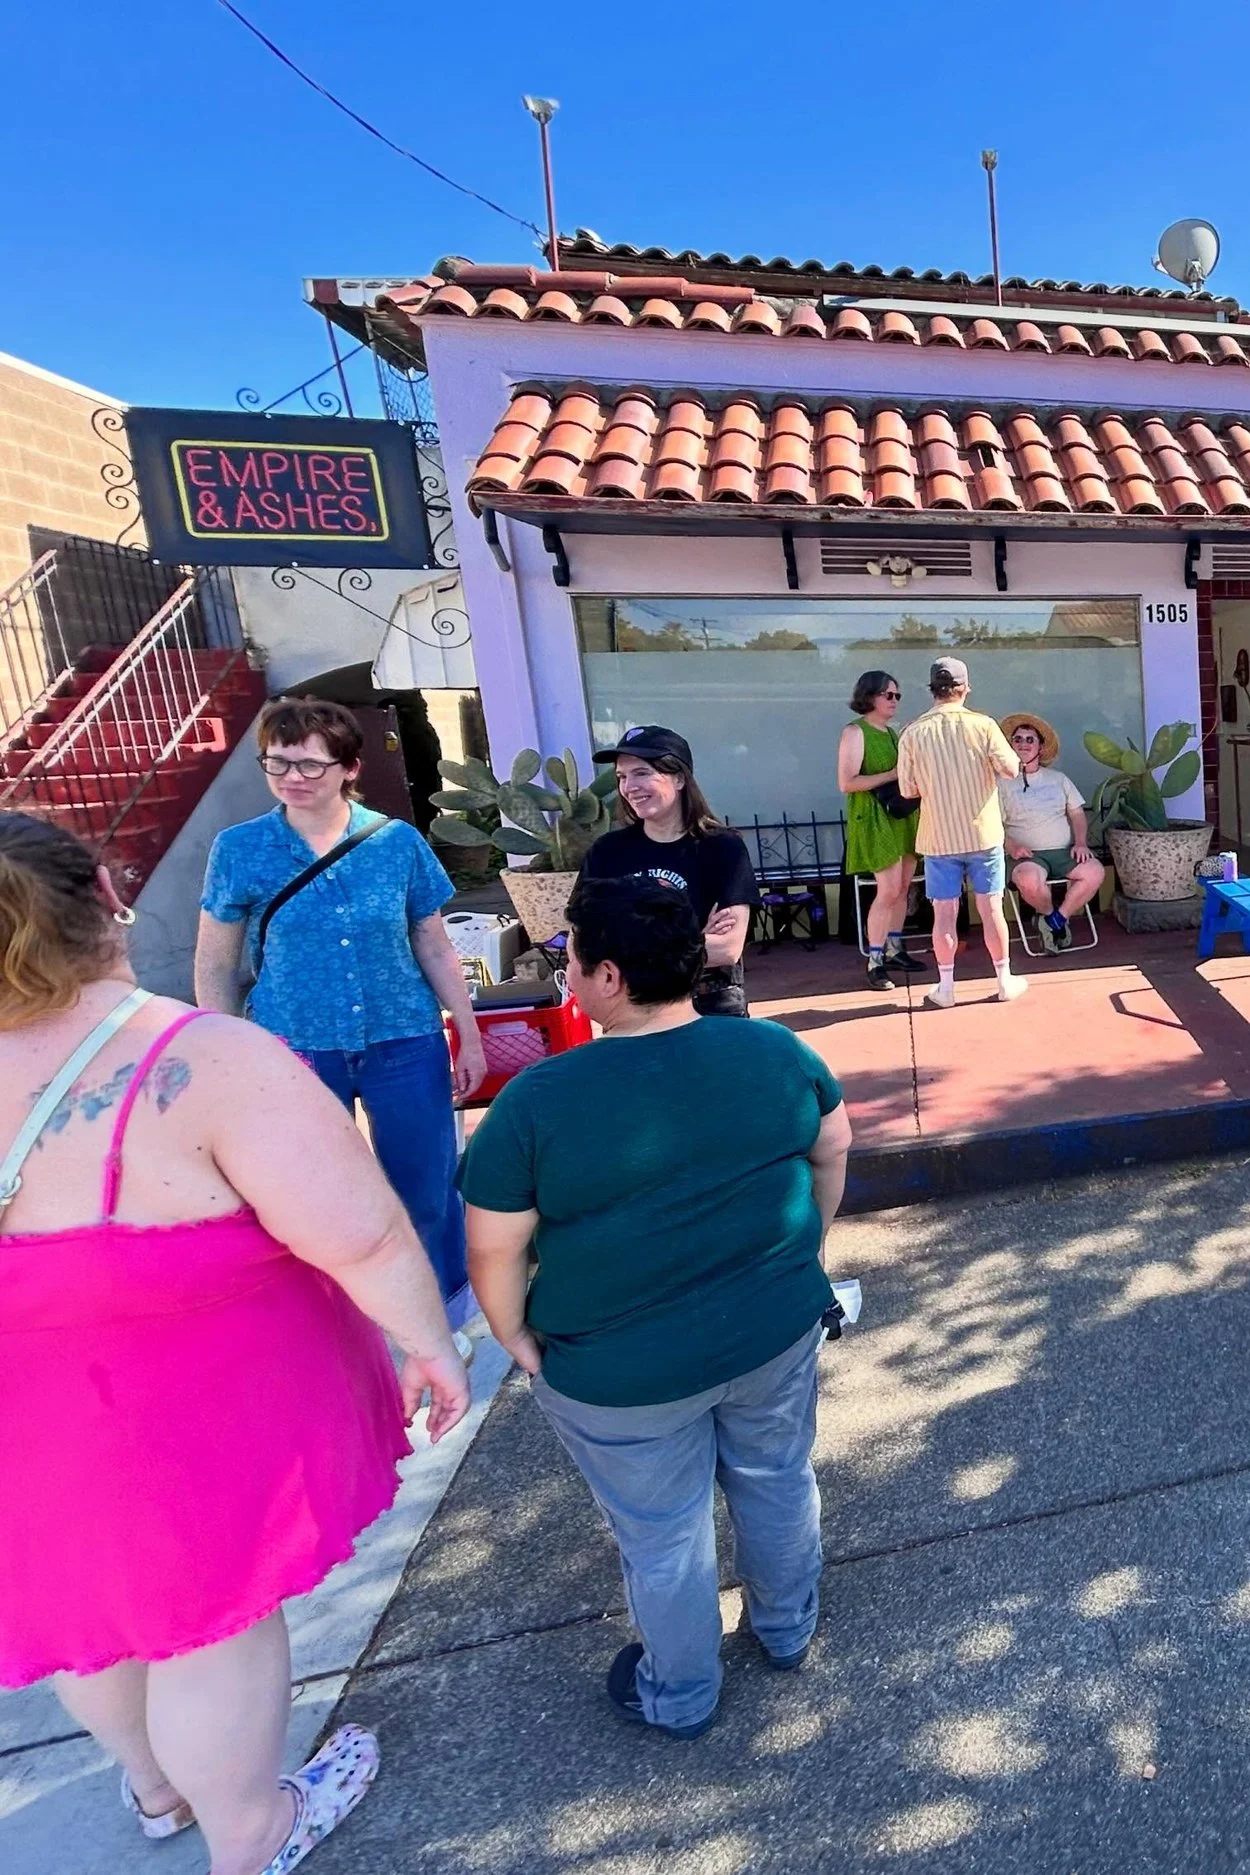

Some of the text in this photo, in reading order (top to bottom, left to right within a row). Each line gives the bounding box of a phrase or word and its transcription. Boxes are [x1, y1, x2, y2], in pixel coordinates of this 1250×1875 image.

[186, 449, 370, 492] EMPIRE
[196, 490, 229, 528] &
[1146, 604, 1188, 623] 1505
[648, 868, 688, 889] RIGHTS
